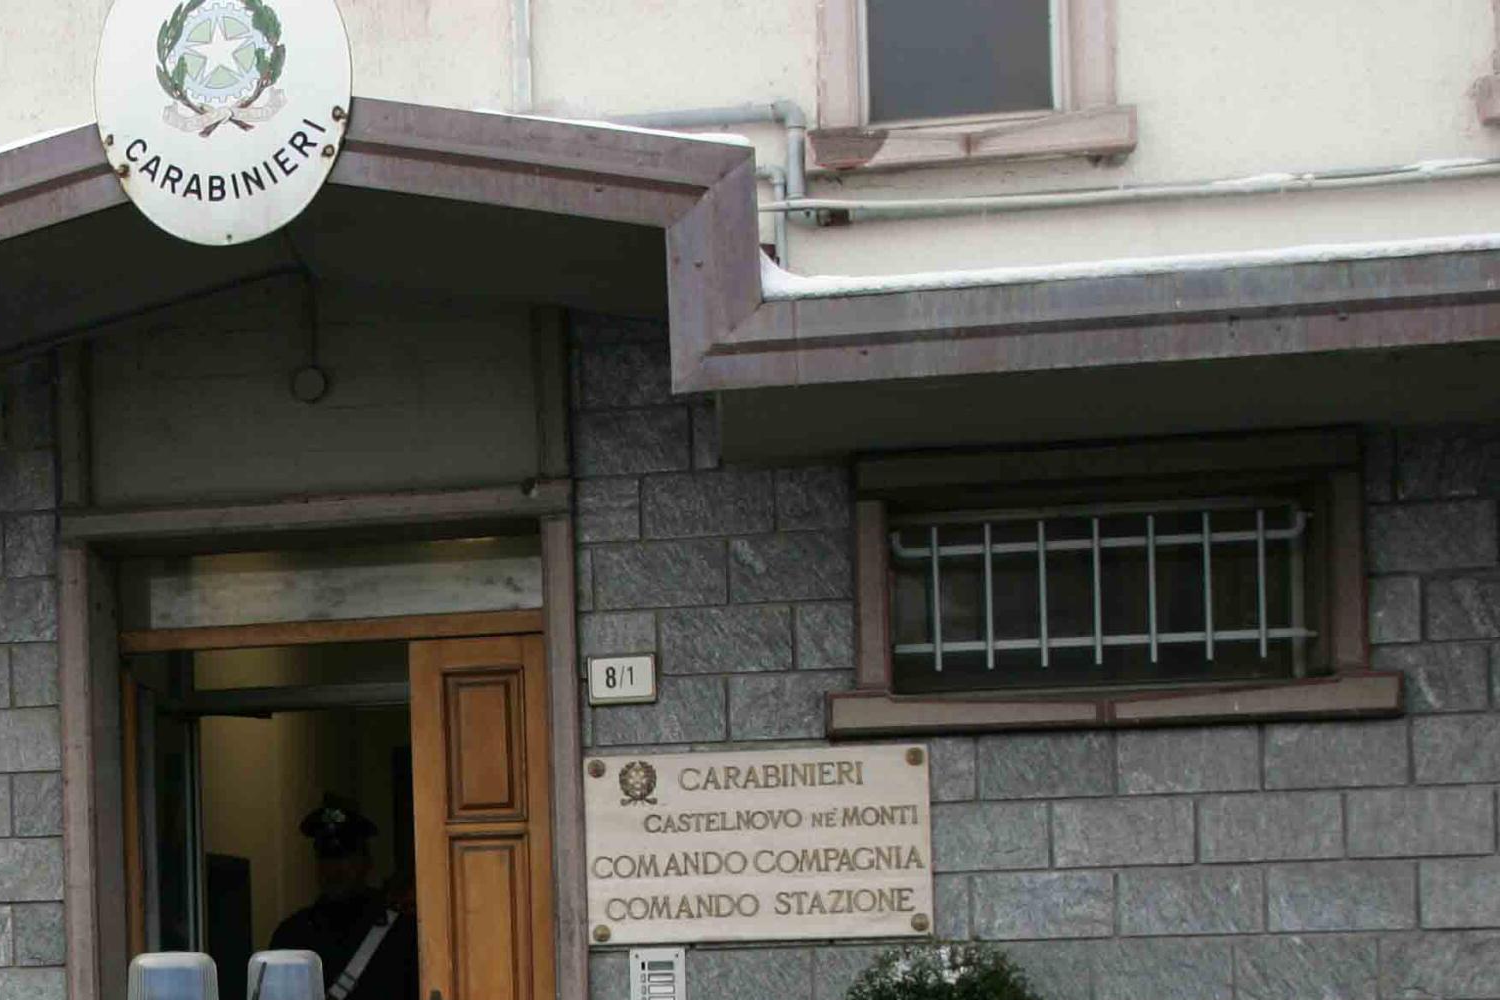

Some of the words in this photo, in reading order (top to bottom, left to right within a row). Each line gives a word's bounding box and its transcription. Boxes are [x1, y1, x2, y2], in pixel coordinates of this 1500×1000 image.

[125, 118, 326, 203] CARABINIERI
[605, 665, 634, 689] 8/1
[677, 761, 864, 791] CARABINIERI
[643, 808, 802, 834] CASTELNOVO
[841, 804, 919, 828] MONTI
[592, 851, 748, 879] COMANDO
[752, 845, 925, 874] COMPAGNIA
[605, 894, 760, 921] COMANDO
[774, 887, 916, 916] STAZIONE
